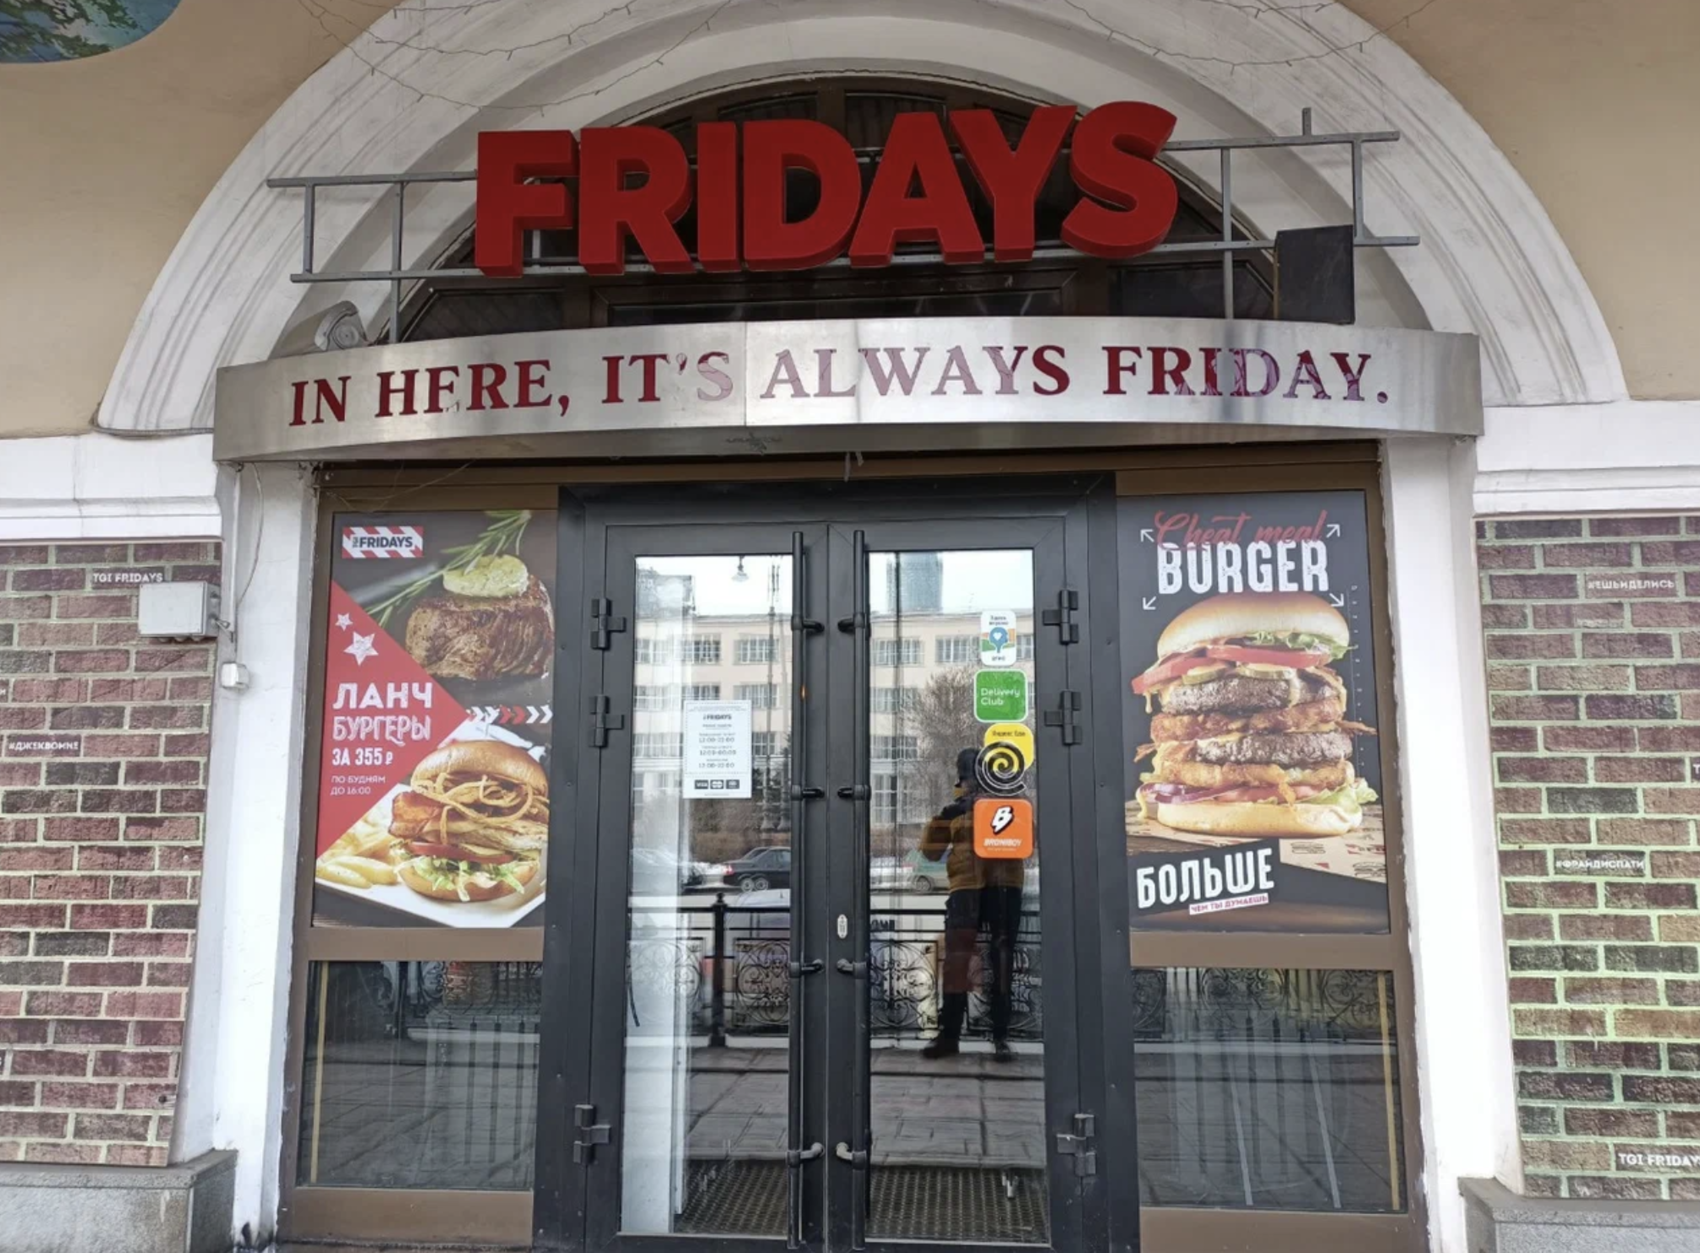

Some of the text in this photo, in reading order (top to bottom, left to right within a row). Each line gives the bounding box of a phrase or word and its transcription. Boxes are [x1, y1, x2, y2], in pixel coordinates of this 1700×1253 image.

[474, 101, 1179, 277] FRIDAYS
[288, 344, 1389, 426] IN HERE, IT'S ALWAYS FRIDAY.
[1154, 510, 1328, 551] Cheat meal
[359, 536, 414, 549] FRIDAYS
[1157, 538, 1329, 595] BURGER
[92, 573, 164, 583] TGI FRIDAYS
[333, 682, 432, 710] ЛАНЧ
[980, 697, 1004, 706] Club
[981, 687, 1020, 698] Delivery
[333, 714, 431, 746] БУРГЕРЫ
[332, 747, 350, 766] ЗА
[355, 747, 383, 766] 355
[331, 775, 386, 785] ПО БУДНЯМ
[330, 786, 372, 796] ДО 16:00
[1136, 847, 1275, 909] БОЛЬШЕ
[1191, 895, 1268, 912] ЧЕМ ТЫ ДУМАЕШЬ
[1618, 1153, 1700, 1167] TGI FRIDAY
